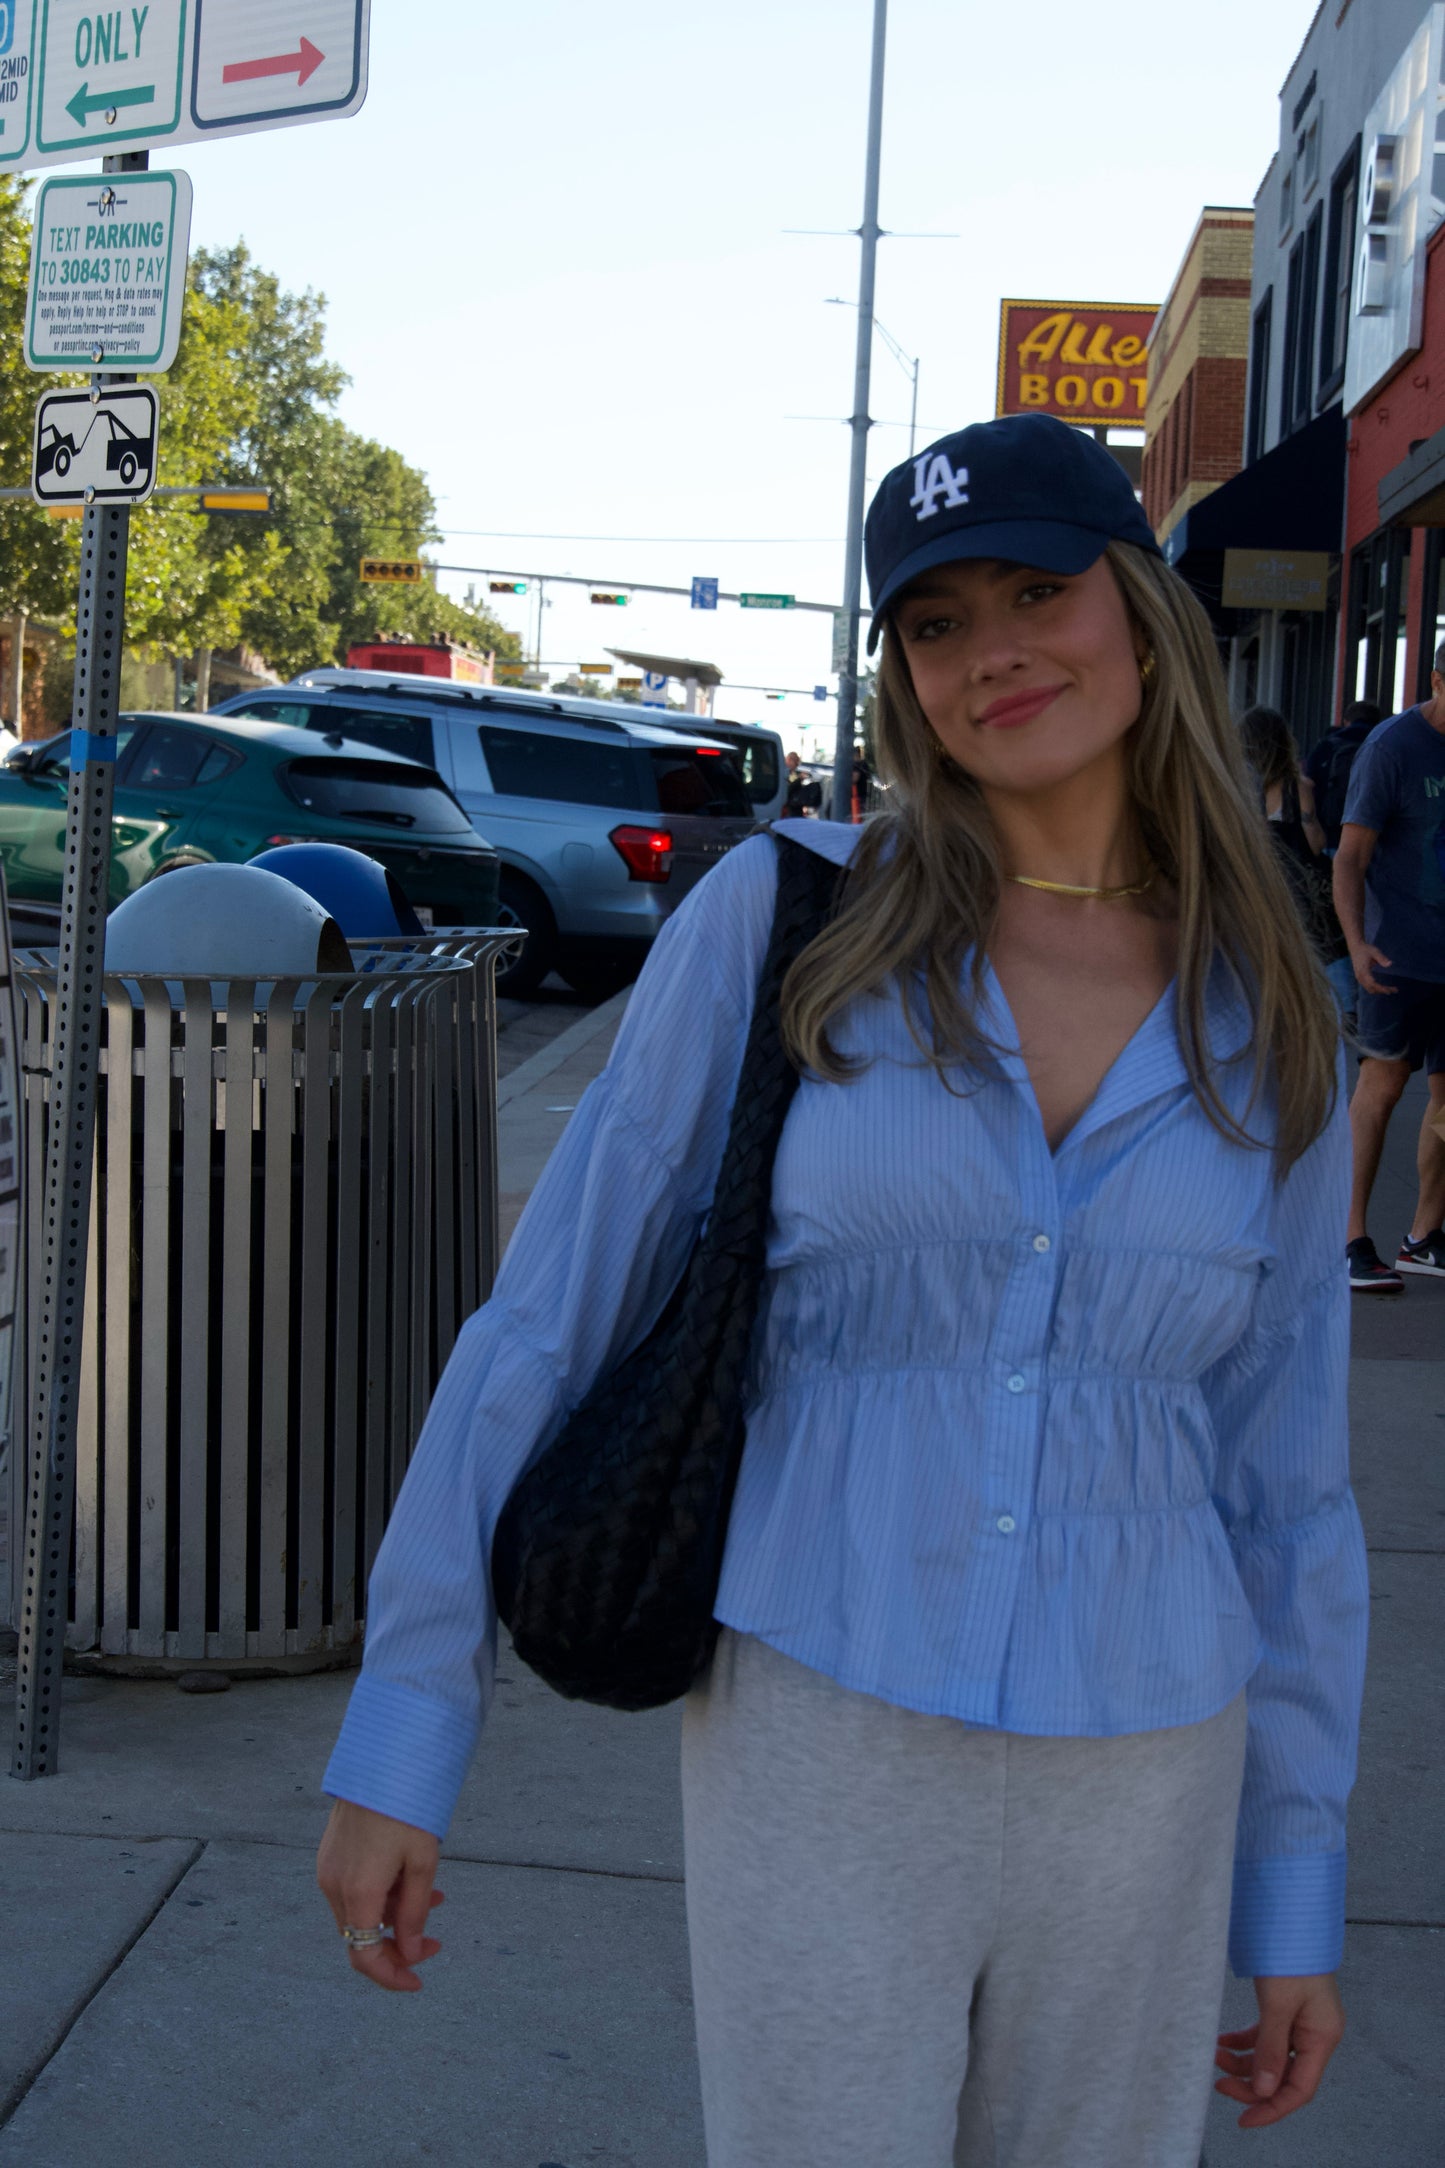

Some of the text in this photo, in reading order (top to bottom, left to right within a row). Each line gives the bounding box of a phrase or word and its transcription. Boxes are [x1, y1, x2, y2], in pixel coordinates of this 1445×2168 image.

[75, 5, 149, 68] ONLY
[50, 221, 163, 252] TEXT PARKING
[41, 256, 165, 285] TO 30843 TO PAY
[38, 290, 47, 301] One
[48, 291, 70, 304] message
[72, 291, 80, 303] per
[104, 288, 114, 303] Msg
[116, 287, 122, 299] &
[124, 288, 135, 299] data
[137, 288, 151, 299] rates
[152, 288, 163, 302] may
[57, 305, 71, 320] Reply
[73, 305, 84, 320] Help
[86, 305, 94, 317] for
[96, 304, 106, 319] help
[109, 306, 115, 317] or
[116, 304, 129, 317] STOP
[131, 304, 136, 317] to
[54, 341, 60, 351] or
[1018, 373, 1147, 409] BOOT
[910, 452, 969, 521] LA
